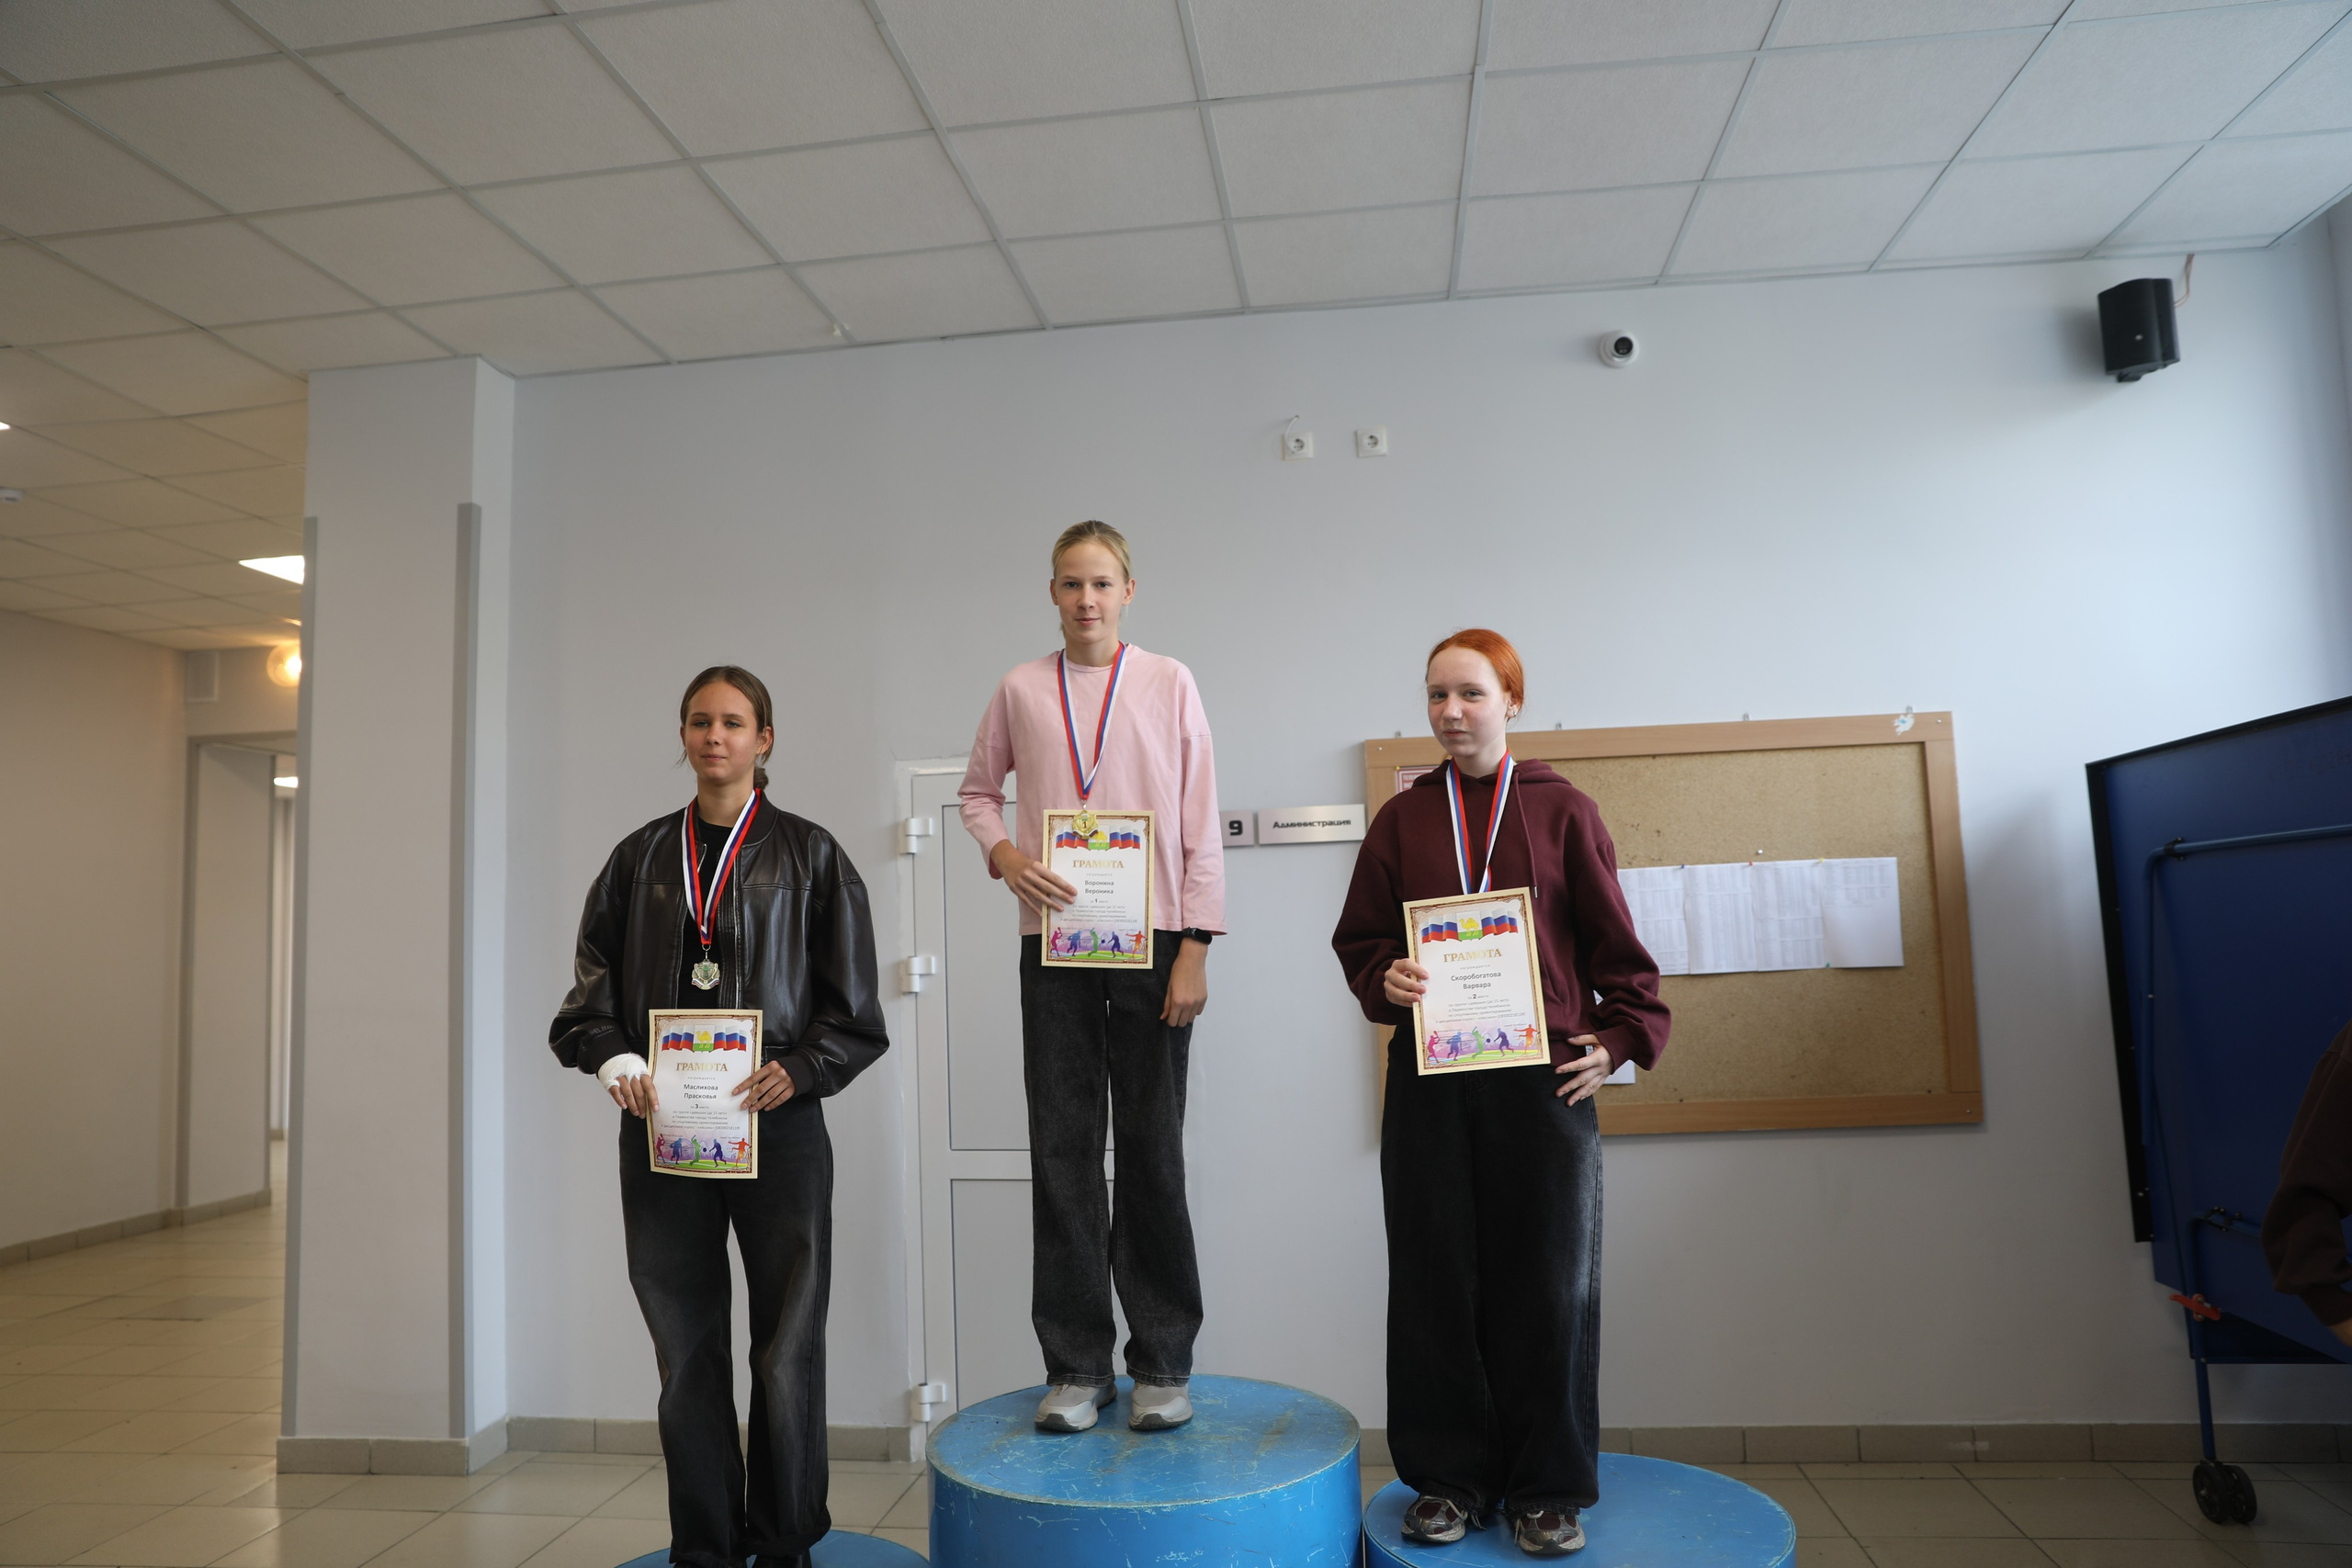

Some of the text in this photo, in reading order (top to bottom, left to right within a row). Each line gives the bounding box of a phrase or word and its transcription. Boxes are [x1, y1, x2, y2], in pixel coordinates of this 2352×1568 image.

[1228, 819, 1243, 836] 9
[1272, 819, 1351, 829] Администрация
[1073, 860, 1124, 868] ГРАМОТА
[1443, 948, 1502, 963] ГРАМОТА
[1451, 972, 1501, 982] Скоробогатова
[1463, 982, 1492, 990] Варвара
[676, 1063, 728, 1072] ГРАМОТА
